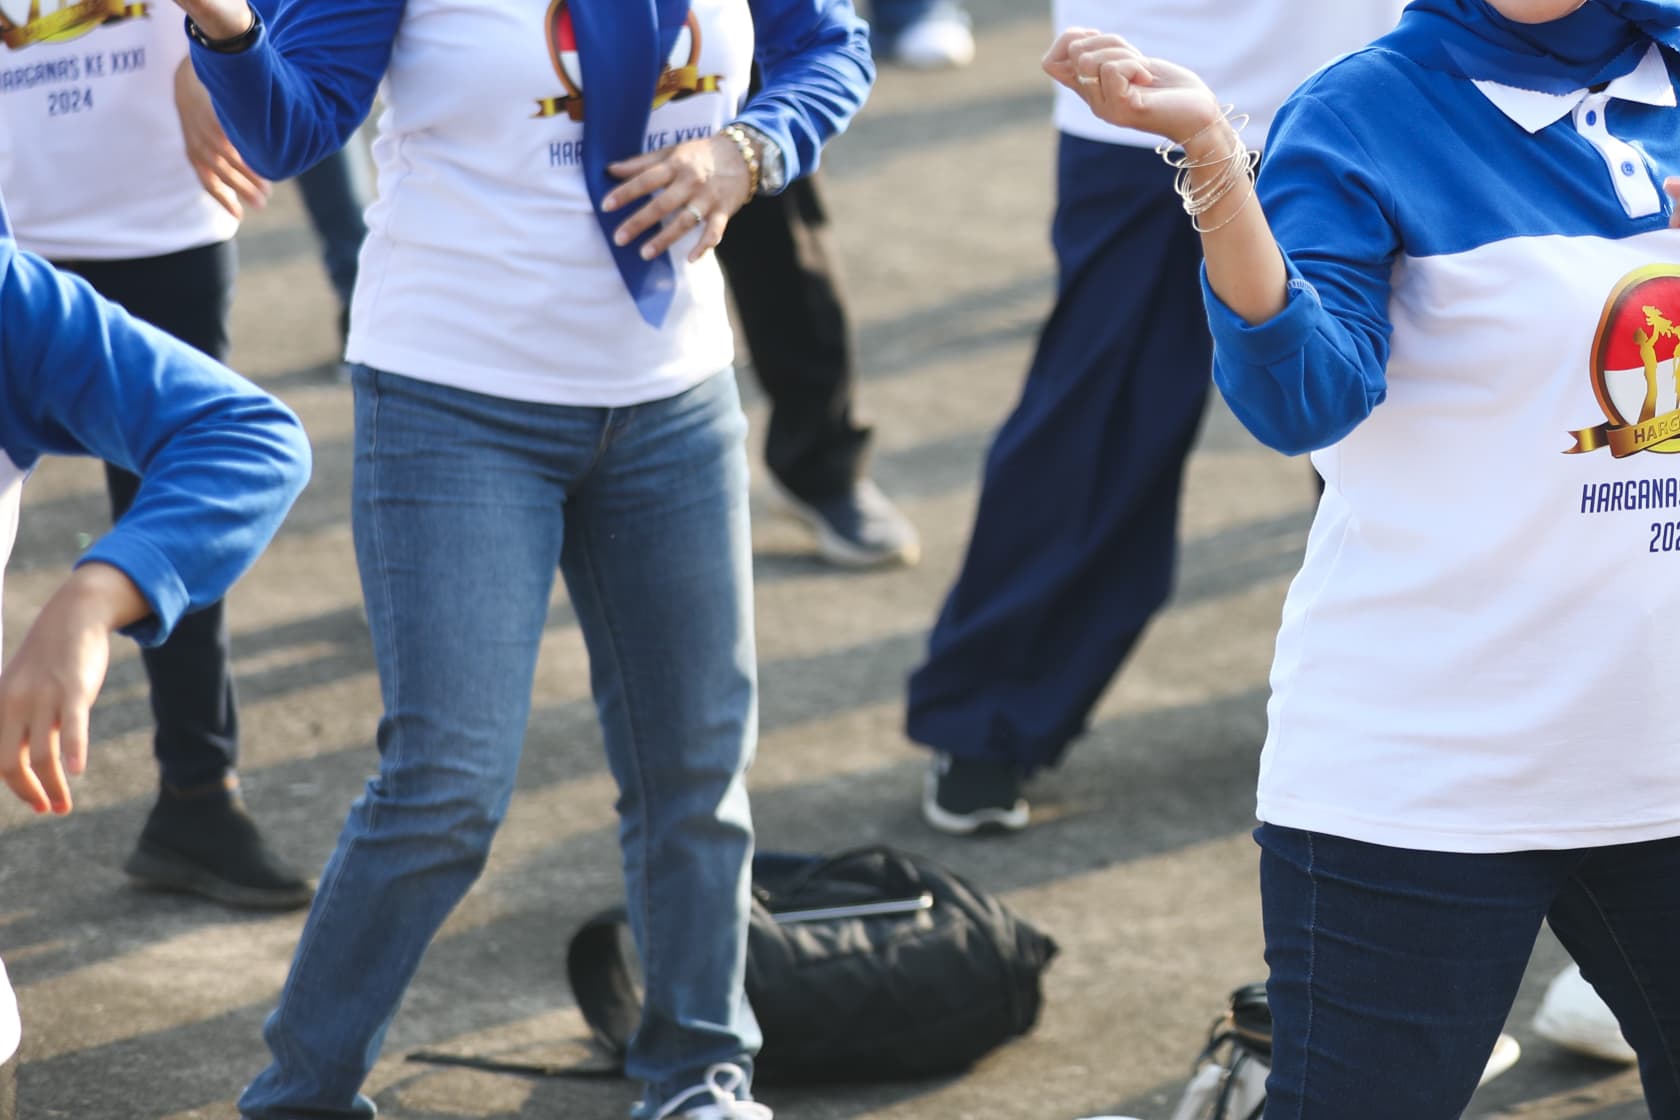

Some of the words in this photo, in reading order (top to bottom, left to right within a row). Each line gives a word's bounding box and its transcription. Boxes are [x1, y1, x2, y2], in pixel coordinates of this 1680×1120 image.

[0, 56, 79, 91] ARGANAS
[85, 54, 104, 76] KE
[112, 47, 145, 73] XXXI
[48, 88, 93, 117] 2024
